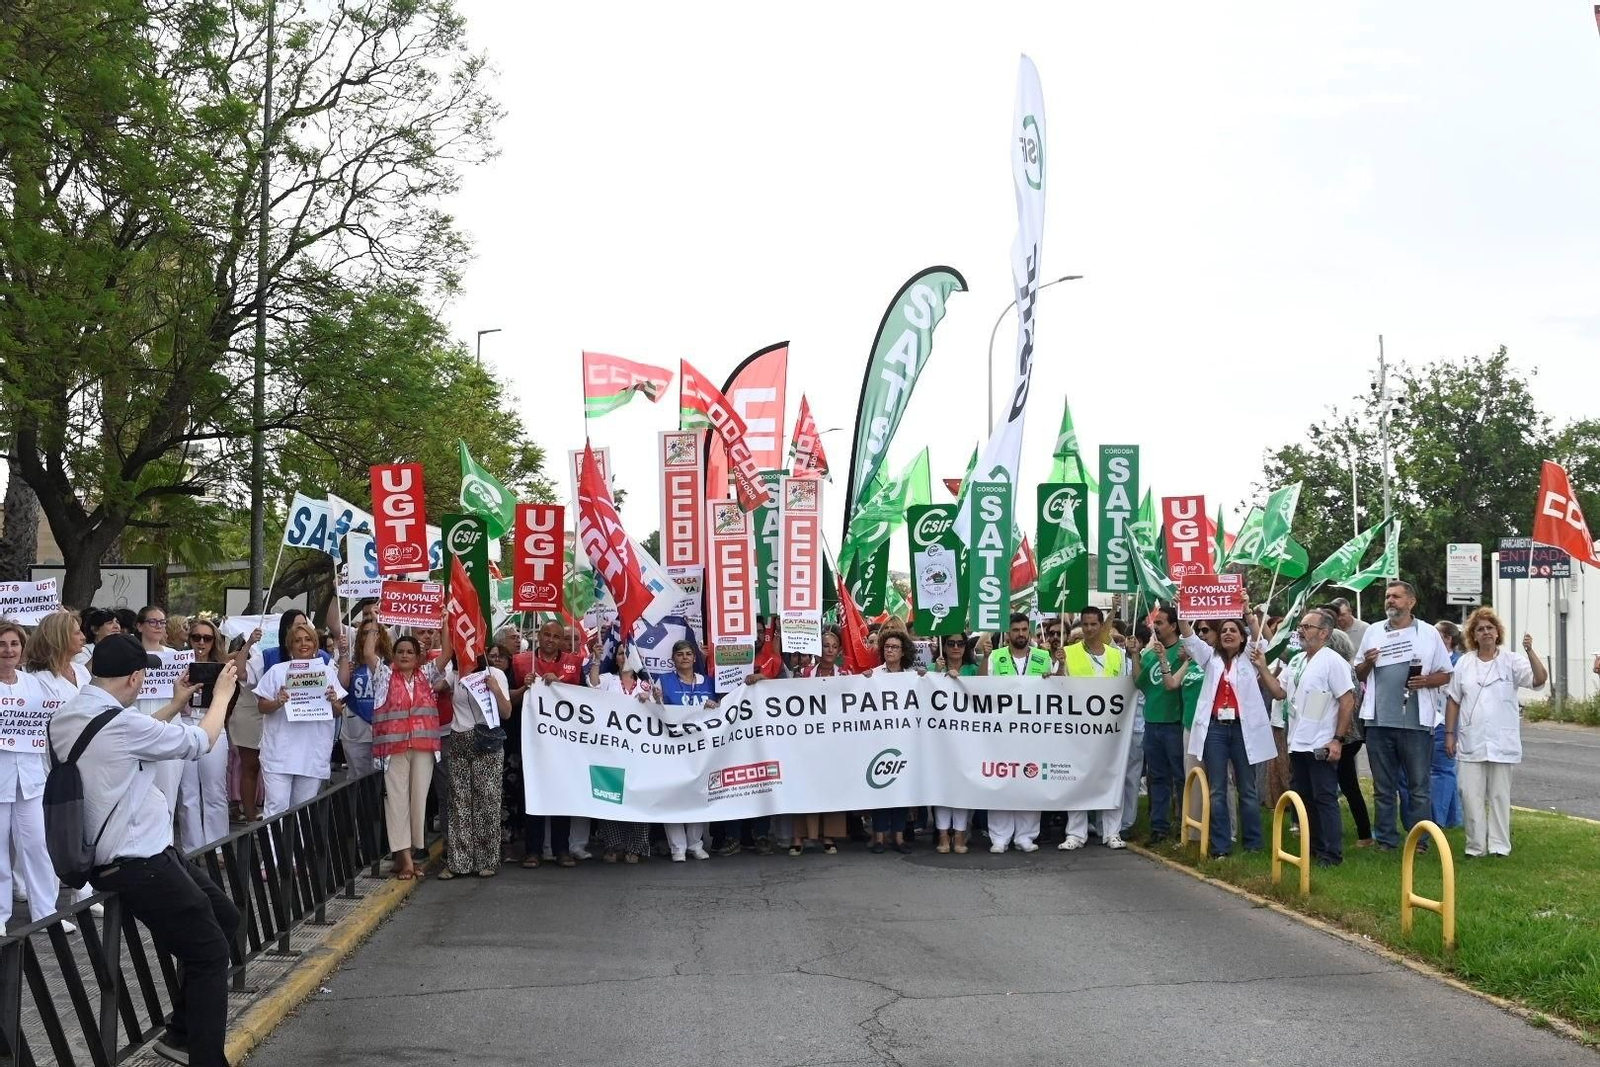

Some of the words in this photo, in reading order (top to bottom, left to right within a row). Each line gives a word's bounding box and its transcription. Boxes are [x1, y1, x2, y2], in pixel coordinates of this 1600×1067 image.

[381, 468, 416, 543] UGT
[671, 475, 693, 562] CCOO
[1104, 457, 1132, 591] SATSE
[1170, 499, 1200, 562] UGT
[524, 509, 555, 581] UGT
[1500, 550, 1570, 561] ENTRADA
[790, 520, 811, 607] CCOO
[977, 495, 1005, 630] SATSE
[36, 582, 51, 591] UGT
[721, 544, 745, 633] CCOO
[20, 604, 61, 613] ACUERDOS
[391, 603, 433, 614] EXISTE
[1190, 596, 1232, 607] EXISTE
[174, 653, 189, 661] UGT
[42, 700, 60, 709] UGT
[538, 697, 595, 725] LOS
[607, 699, 753, 738] ACUERDOS
[765, 694, 827, 717] SON
[841, 689, 920, 713] PARA
[930, 690, 1124, 716] CUMPLIRLOS
[537, 723, 635, 753] CONSEJERA,
[641, 739, 706, 755] CUMPLE
[712, 734, 726, 748] EL
[728, 724, 798, 743] ACUERDO
[804, 722, 825, 735] DE
[832, 717, 911, 733] PRIMARIA
[915, 717, 922, 728] Y
[927, 717, 1003, 733] CARRERA
[1009, 721, 1121, 735] PROFESIONAL
[724, 765, 767, 783] CCOO
[982, 762, 1020, 778] UGT
[594, 788, 621, 801] SATSE
